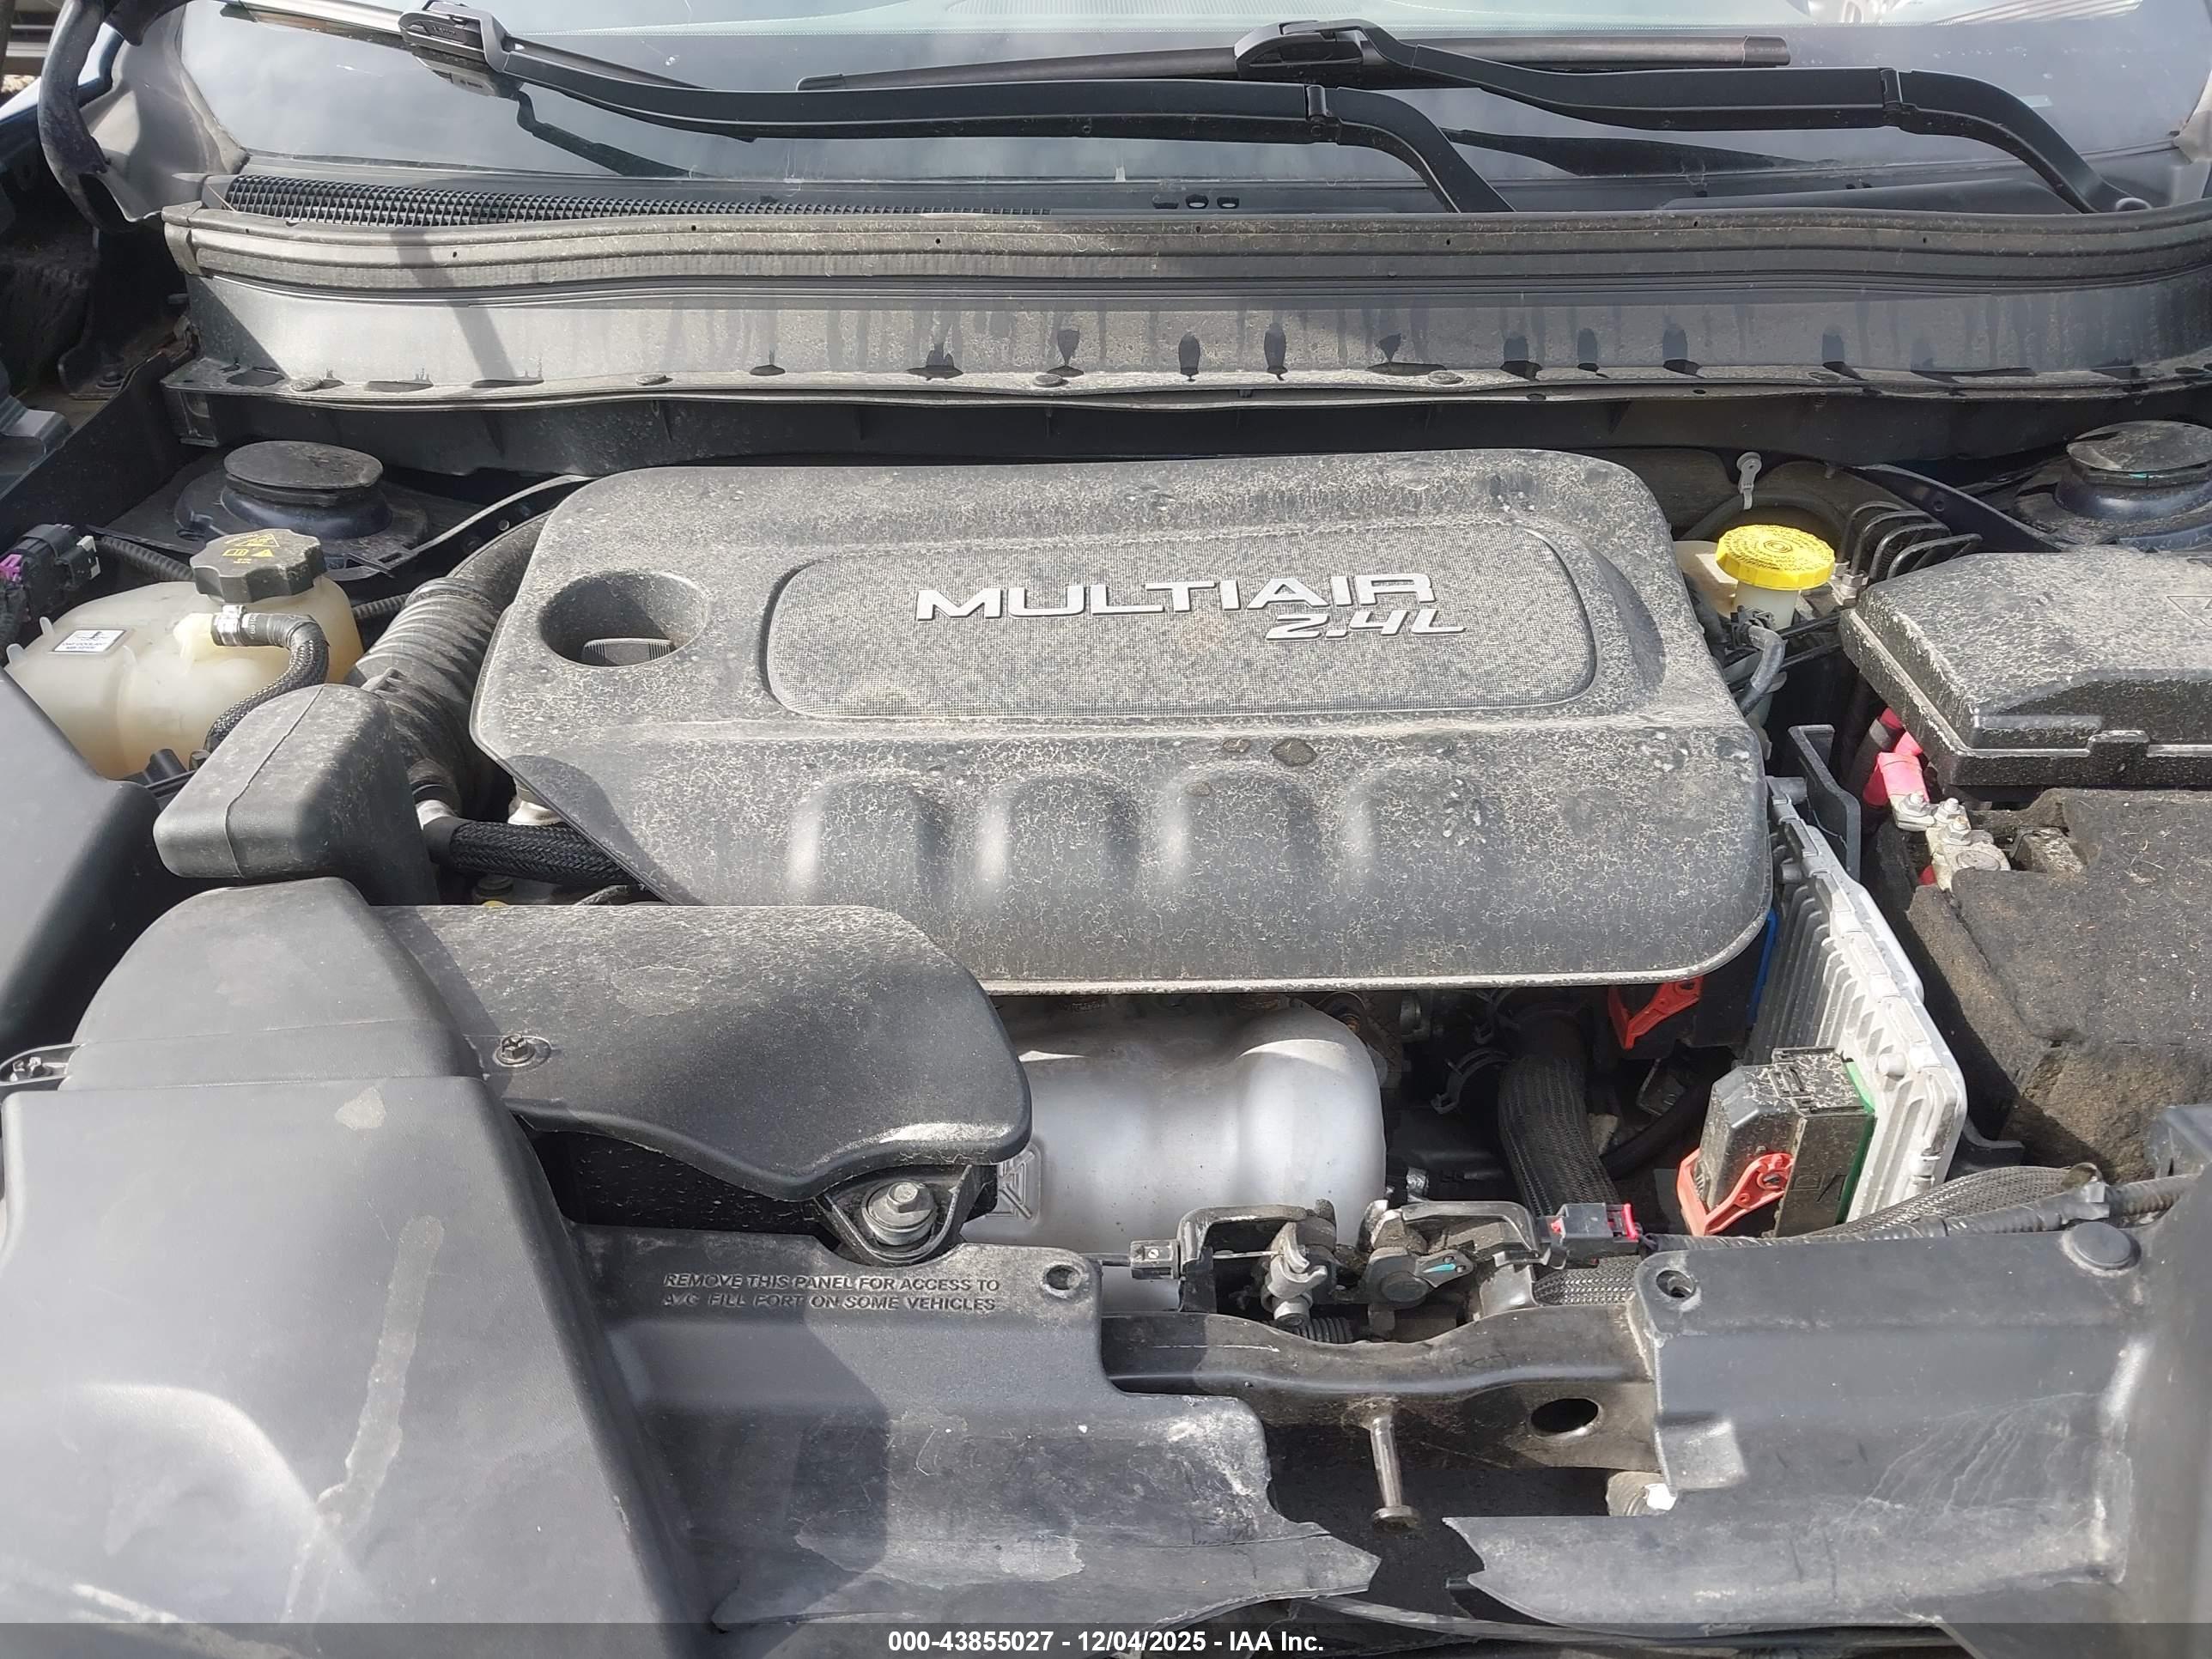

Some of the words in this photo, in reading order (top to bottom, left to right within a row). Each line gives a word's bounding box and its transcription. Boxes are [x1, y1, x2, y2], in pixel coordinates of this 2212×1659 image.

[915, 572, 1437, 620] MULTIAIR
[1266, 608, 1466, 641] 2.4L
[664, 1273, 743, 1288] REMOVE
[747, 1274, 791, 1290] THIS
[795, 1275, 853, 1290] PANEL
[858, 1277, 896, 1291] FOR
[900, 1278, 972, 1292] ACCESS
[977, 1279, 1000, 1292] TO
[709, 1293, 747, 1307] FILL
[811, 1295, 840, 1308] ON
[844, 1295, 899, 1310] SOME
[906, 1296, 996, 1310] VEHICLES
